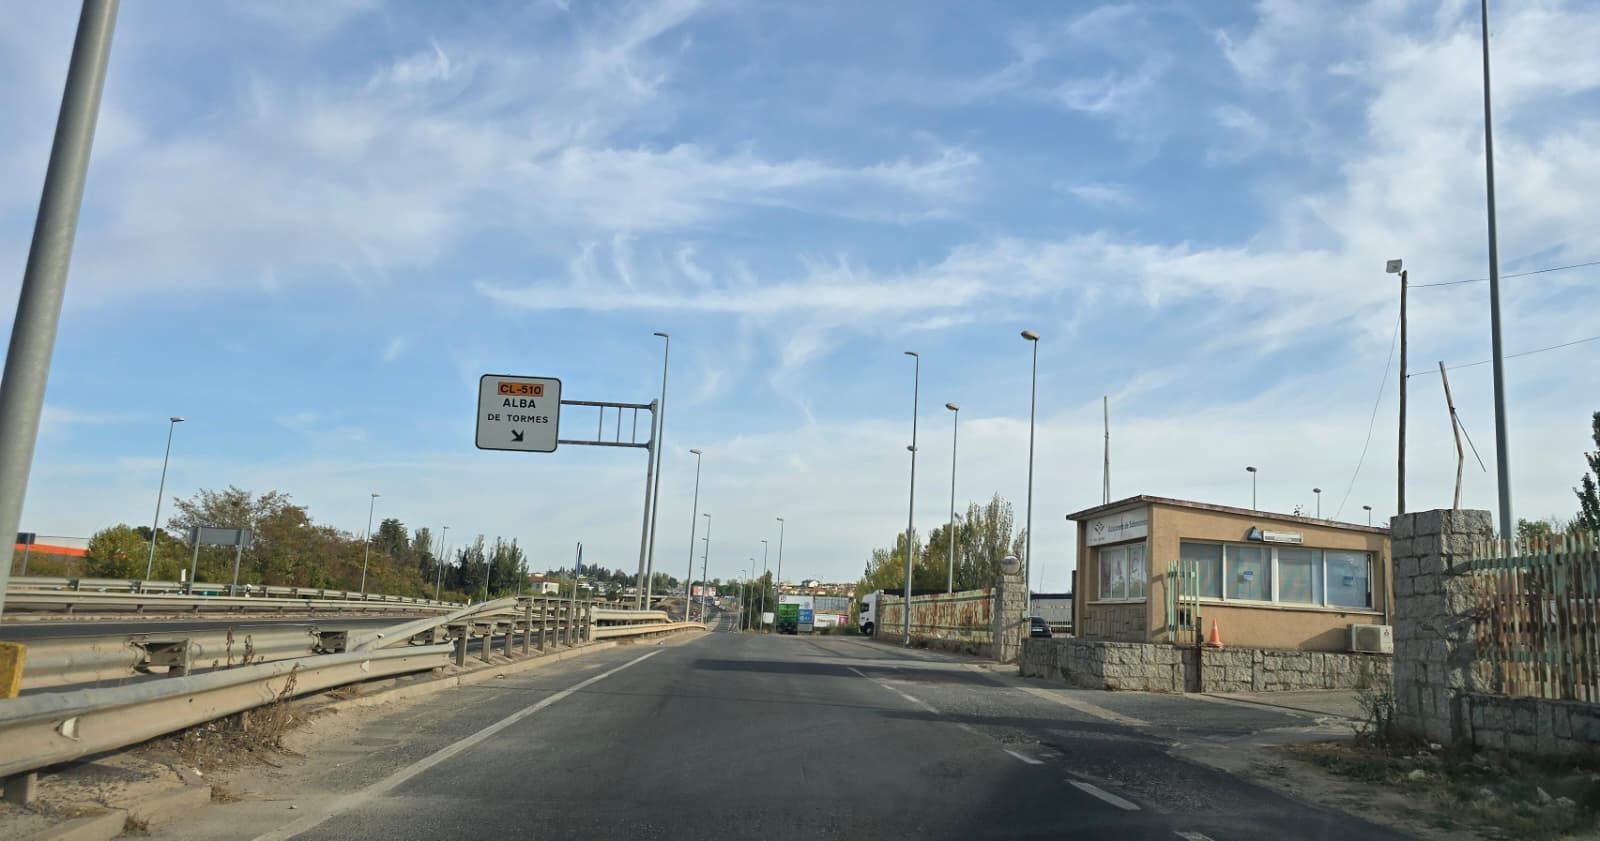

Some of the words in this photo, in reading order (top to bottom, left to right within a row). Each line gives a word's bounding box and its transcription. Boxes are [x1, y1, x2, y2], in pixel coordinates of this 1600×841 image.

[500, 384, 541, 395] CL-510
[502, 398, 536, 409] ALBA
[487, 413, 501, 421] DE
[507, 414, 549, 424] TORMES
